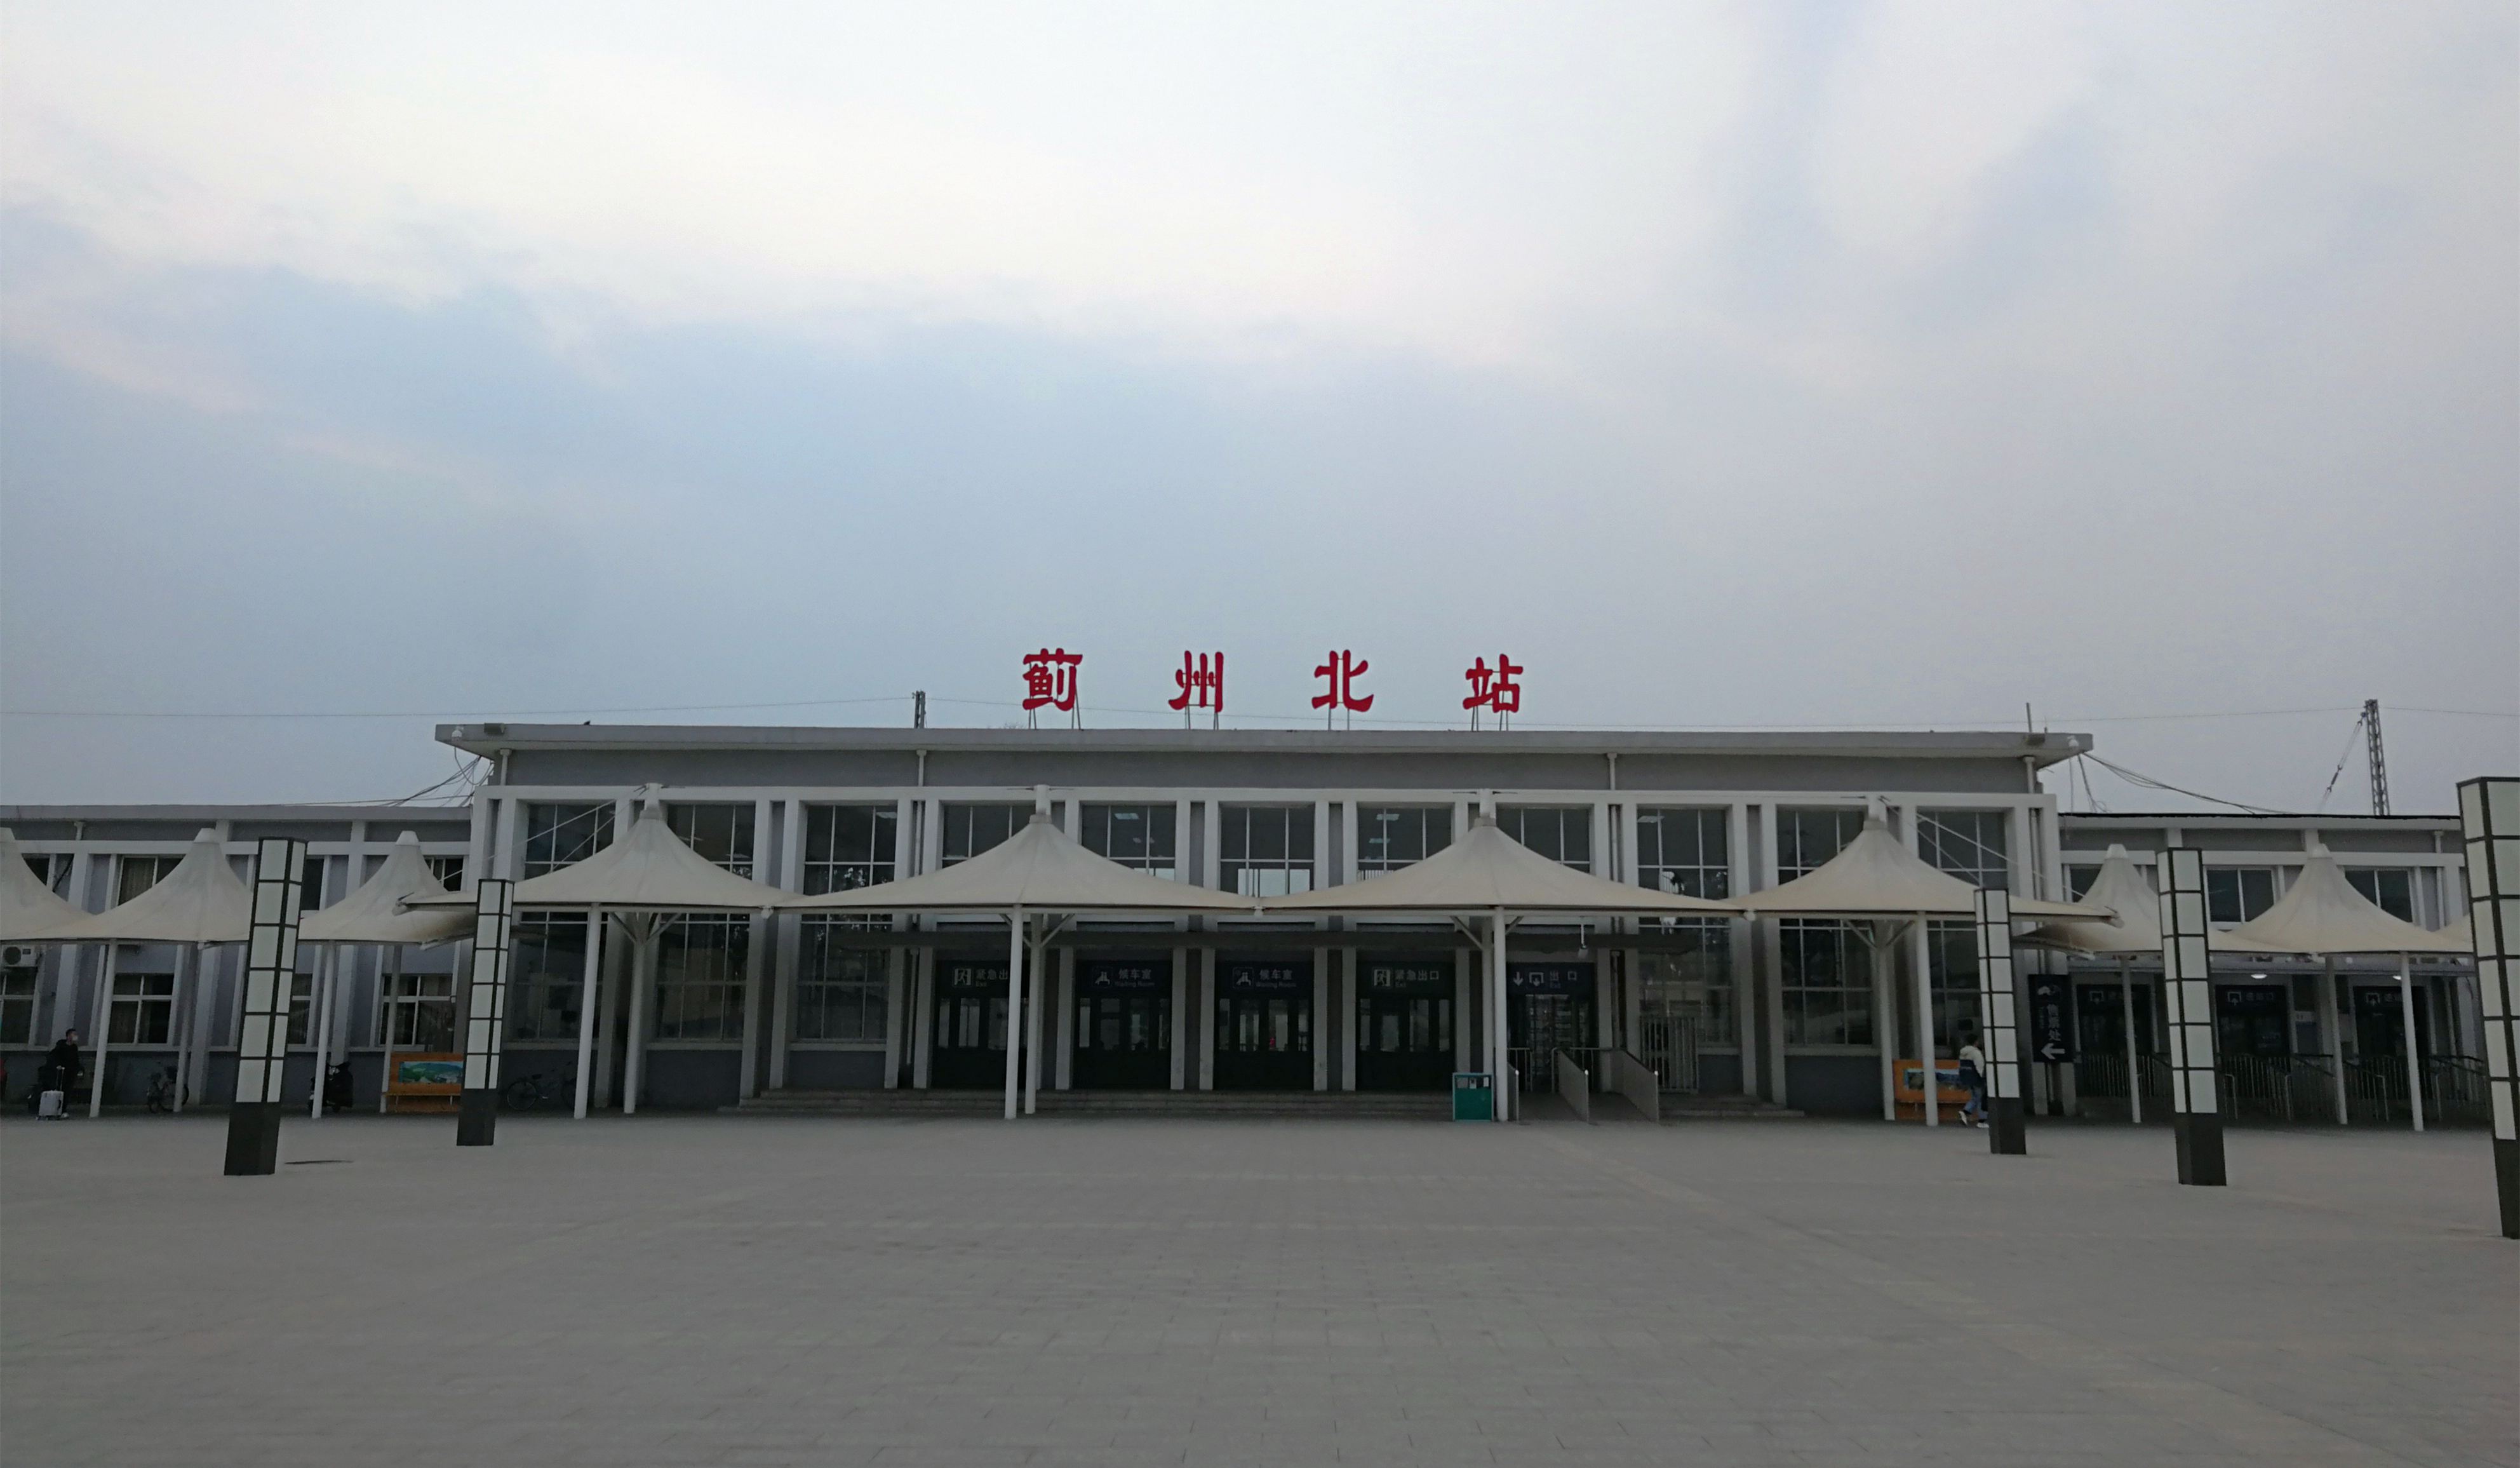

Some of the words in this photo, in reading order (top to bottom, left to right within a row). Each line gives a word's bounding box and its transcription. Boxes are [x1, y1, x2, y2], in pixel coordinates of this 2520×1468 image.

[1022, 648, 1523, 712] 蓟州北站
[976, 969, 1009, 980] 紧急出
[1118, 968, 1151, 980] 候车室
[1259, 969, 1292, 981] 候车室
[1395, 969, 1439, 981] 紧急出口
[1550, 970, 1578, 981] 出口
